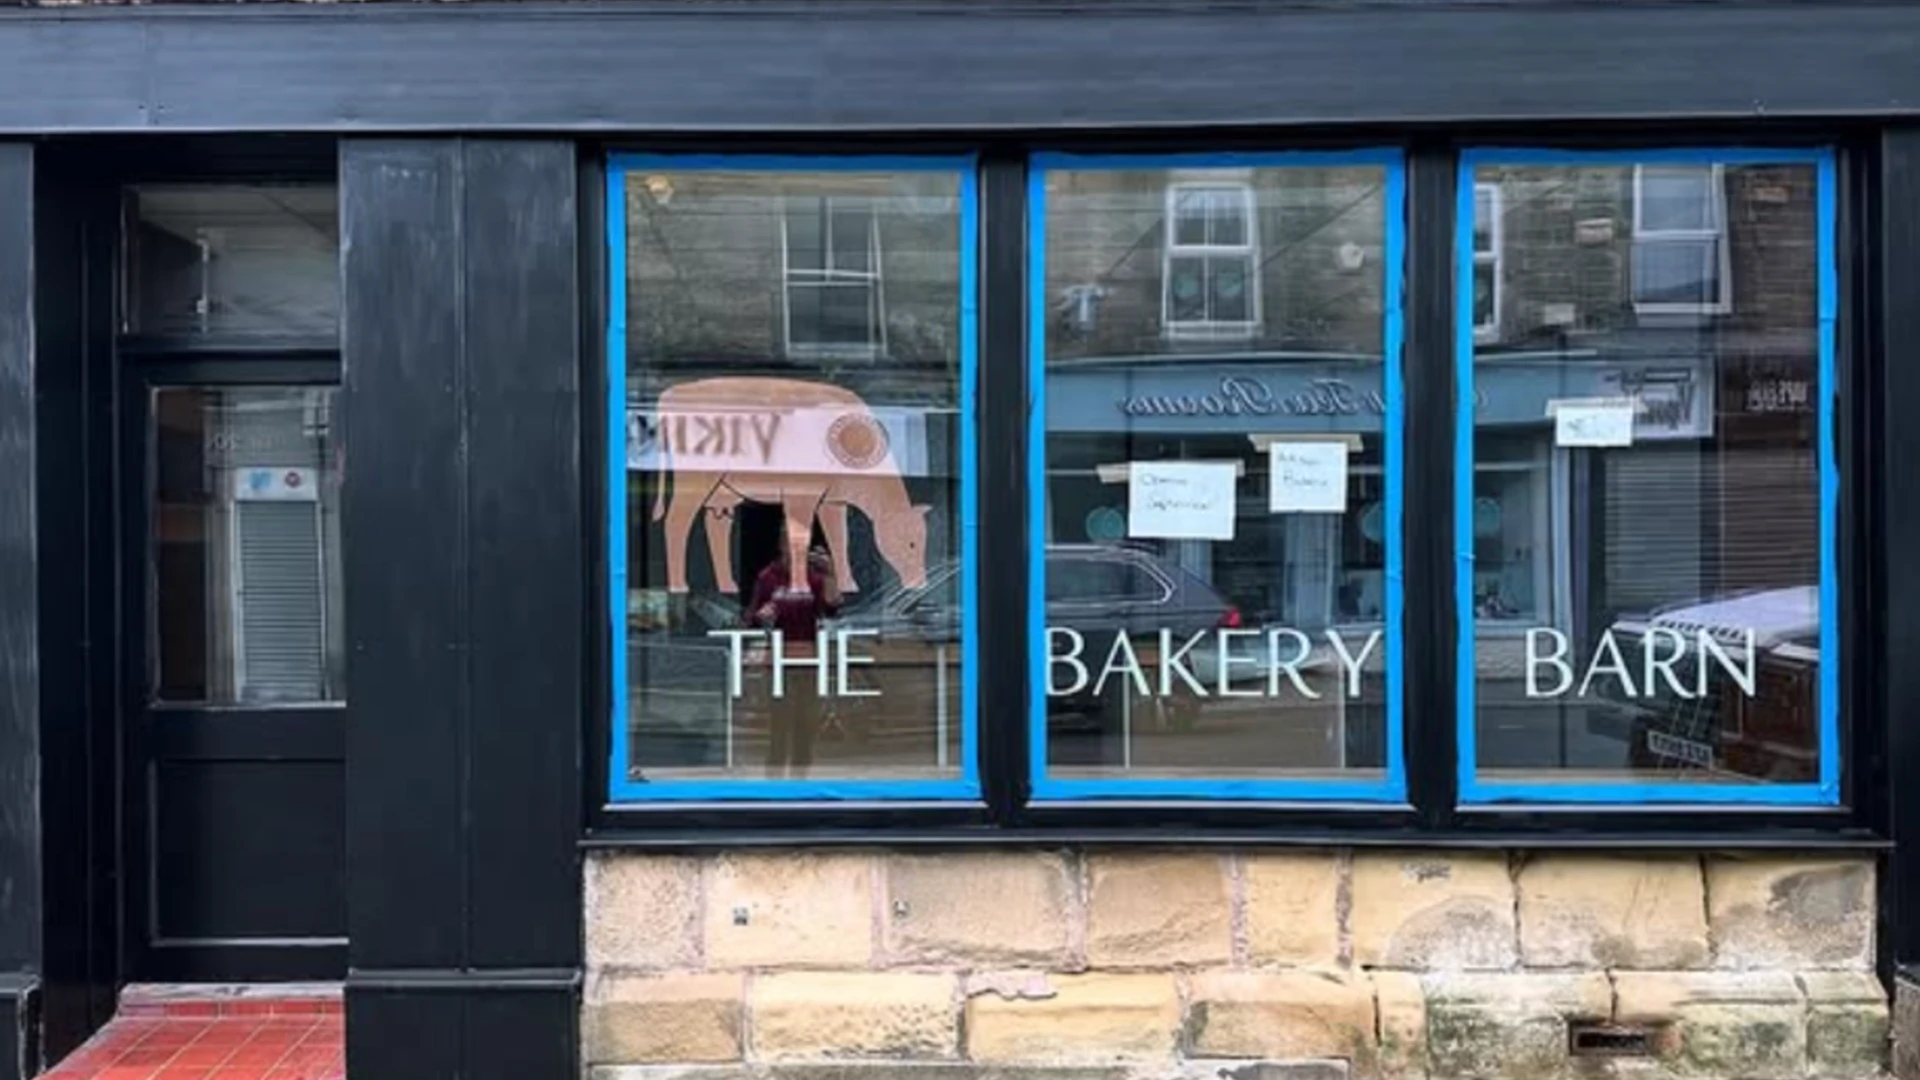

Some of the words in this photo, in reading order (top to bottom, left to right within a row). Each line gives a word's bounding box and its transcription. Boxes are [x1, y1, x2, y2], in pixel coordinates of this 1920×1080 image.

[707, 629, 882, 697] THE
[1045, 627, 1383, 698] BAKERY
[1525, 627, 1756, 698] BARN
